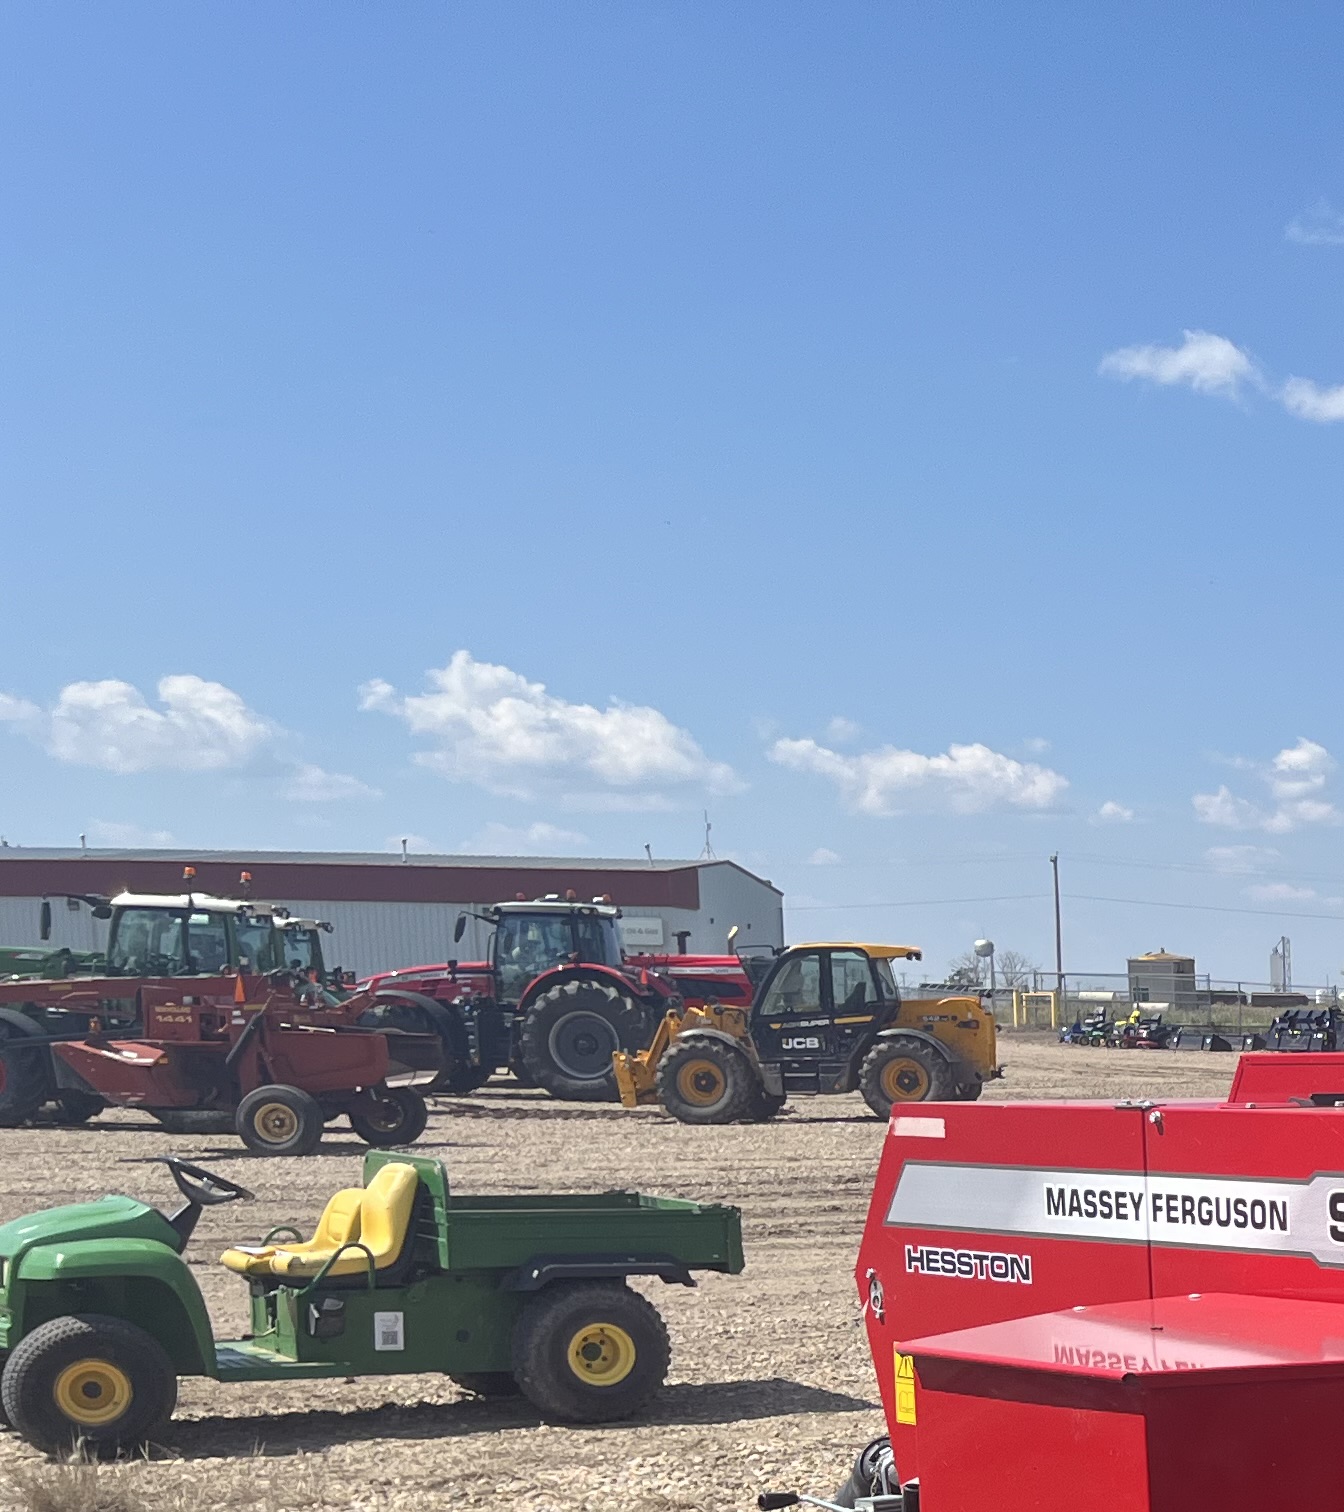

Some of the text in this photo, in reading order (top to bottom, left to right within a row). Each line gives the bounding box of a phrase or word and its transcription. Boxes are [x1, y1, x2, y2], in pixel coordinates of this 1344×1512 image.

[781, 1036, 820, 1050] JCB
[1045, 1186, 1145, 1222] MASSEY
[1151, 1192, 1289, 1232] FERGUSON
[905, 1246, 1031, 1282] HESSTON
